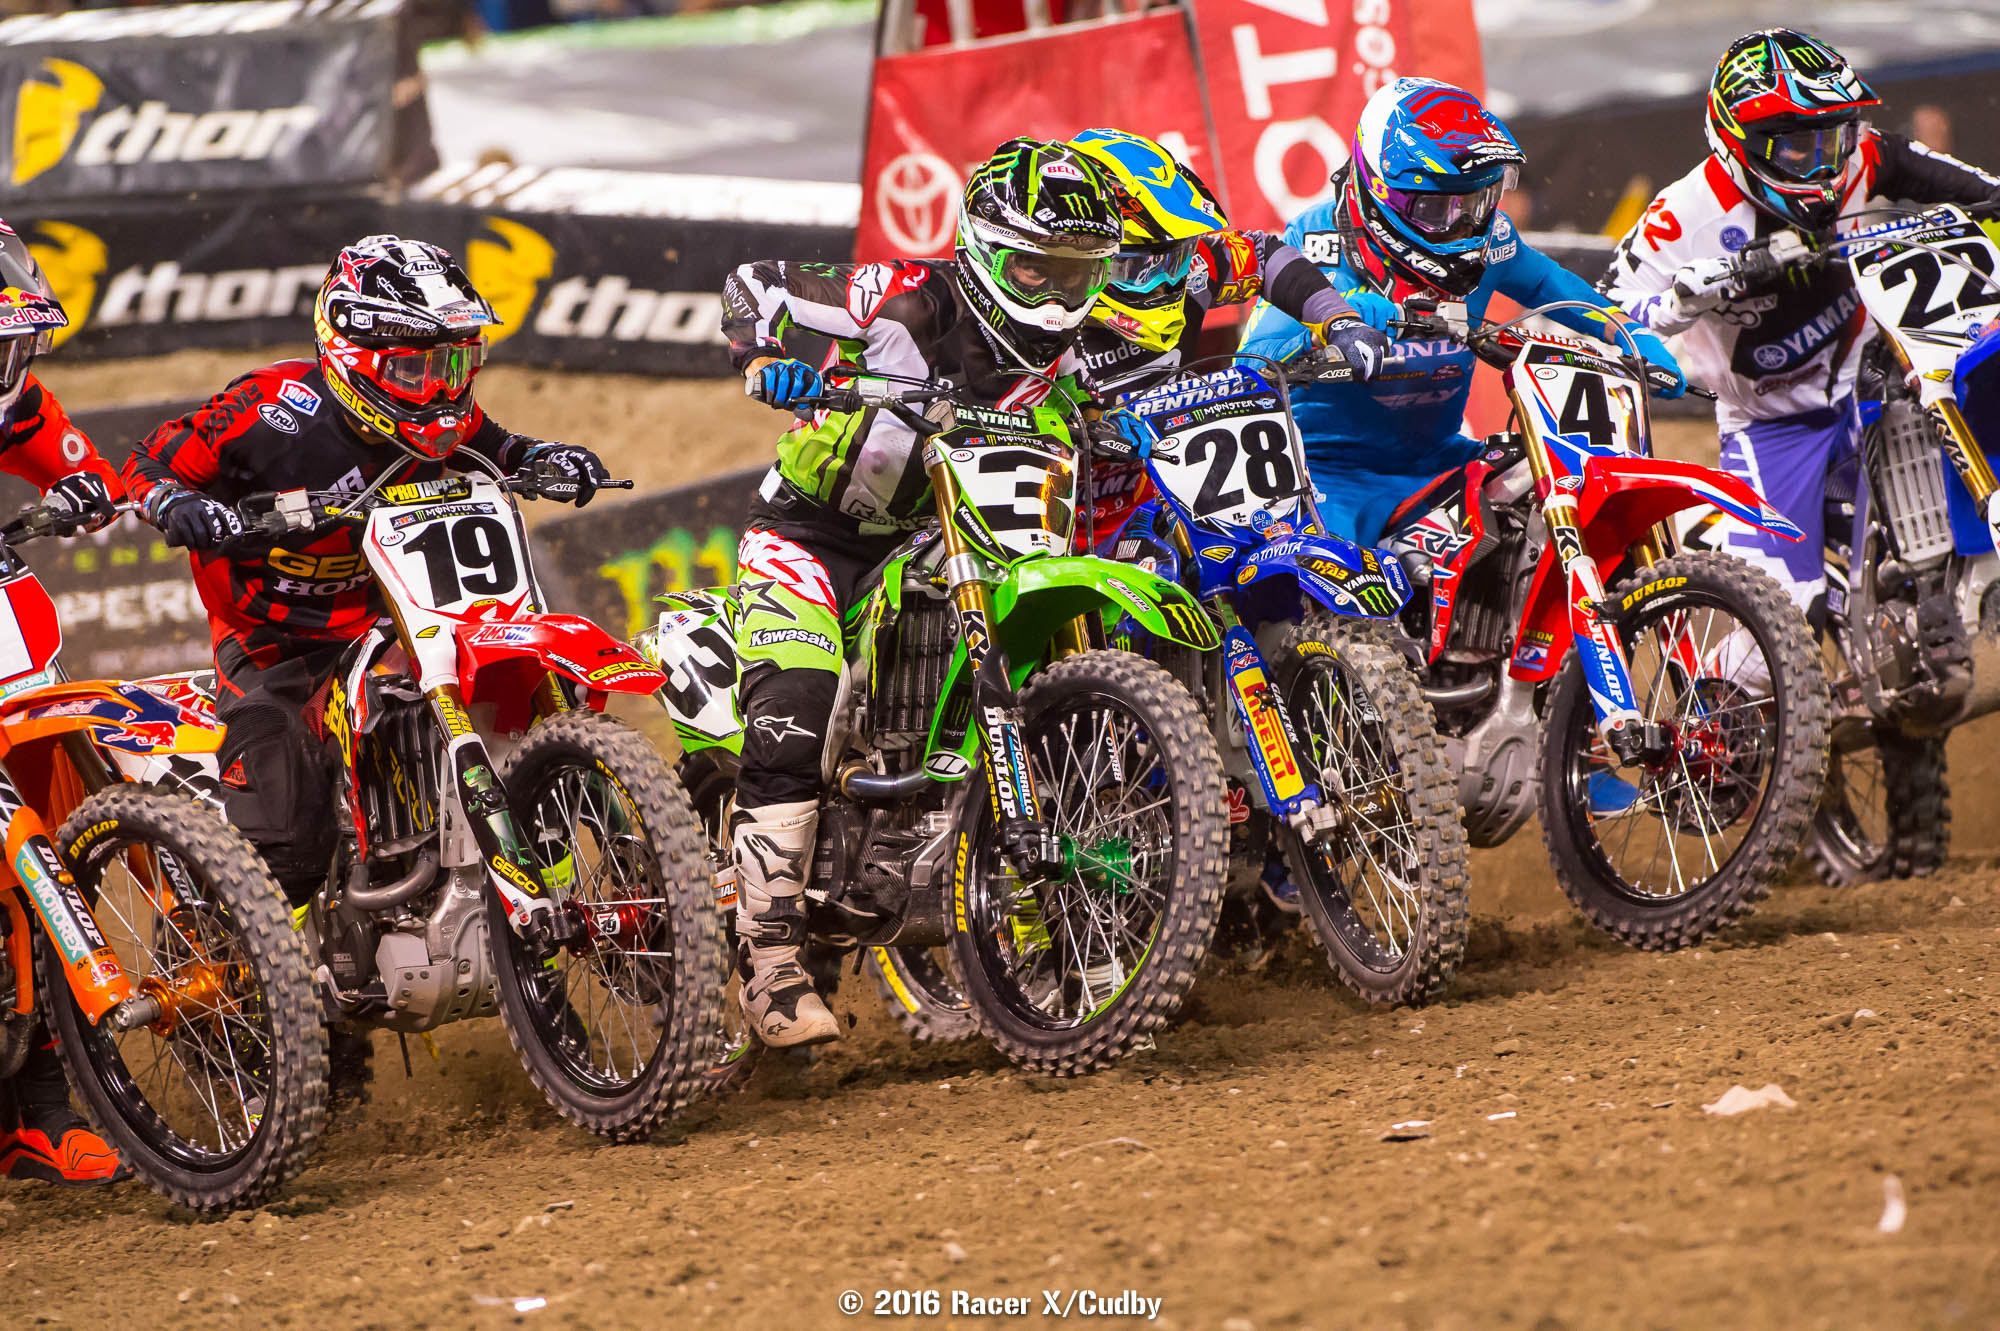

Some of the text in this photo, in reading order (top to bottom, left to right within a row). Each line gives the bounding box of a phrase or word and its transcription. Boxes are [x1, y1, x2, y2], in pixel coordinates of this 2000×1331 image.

[75, 101, 320, 167] thor
[1047, 165, 1077, 178] BELL
[1050, 218, 1119, 237] MONSTER
[1368, 219, 1406, 253] RIDE
[408, 261, 443, 273] Arai
[1404, 252, 1449, 279] RED
[1880, 242, 2000, 328] 22
[0, 306, 68, 328] ed Bull
[1317, 368, 1351, 379] ARC
[1650, 372, 1678, 386] ARC
[286, 384, 314, 410] 100%
[327, 367, 396, 436] GEICO
[1204, 399, 1256, 415] MONSTER
[264, 406, 294, 429] Arai
[956, 407, 1033, 430] RENTHAL
[997, 435, 1045, 447] MONSTER
[1099, 440, 1132, 453] ARC
[1185, 420, 1296, 521] 28
[546, 483, 578, 492] ARC
[976, 450, 1074, 539] 3
[426, 504, 476, 516] MONSTER
[958, 507, 994, 546] Kawasaki
[1261, 541, 1303, 561] TOYOTA
[1399, 525, 1475, 559] CRF
[402, 516, 518, 608] 19
[1343, 574, 1386, 592] YAMAHA
[1622, 577, 1688, 611] DUNLOP
[474, 599, 498, 608] GEICO
[750, 628, 838, 656] Kawasaki
[546, 653, 588, 673] DUNLOP
[588, 661, 660, 682] GEICO
[660, 626, 738, 721] 3
[1587, 619, 1625, 704] DUNLOP
[6, 672, 49, 695] MOTOREX
[603, 671, 662, 686] HONDA
[983, 706, 1018, 820] DUNLOP
[1015, 751, 1035, 817] CARRILLO
[69, 819, 119, 860] DUNLOP
[492, 855, 540, 895] GEICO
[954, 832, 969, 934] DUNLOP
[37, 845, 106, 947] DULOP
[32, 877, 86, 957] MOTOREX
